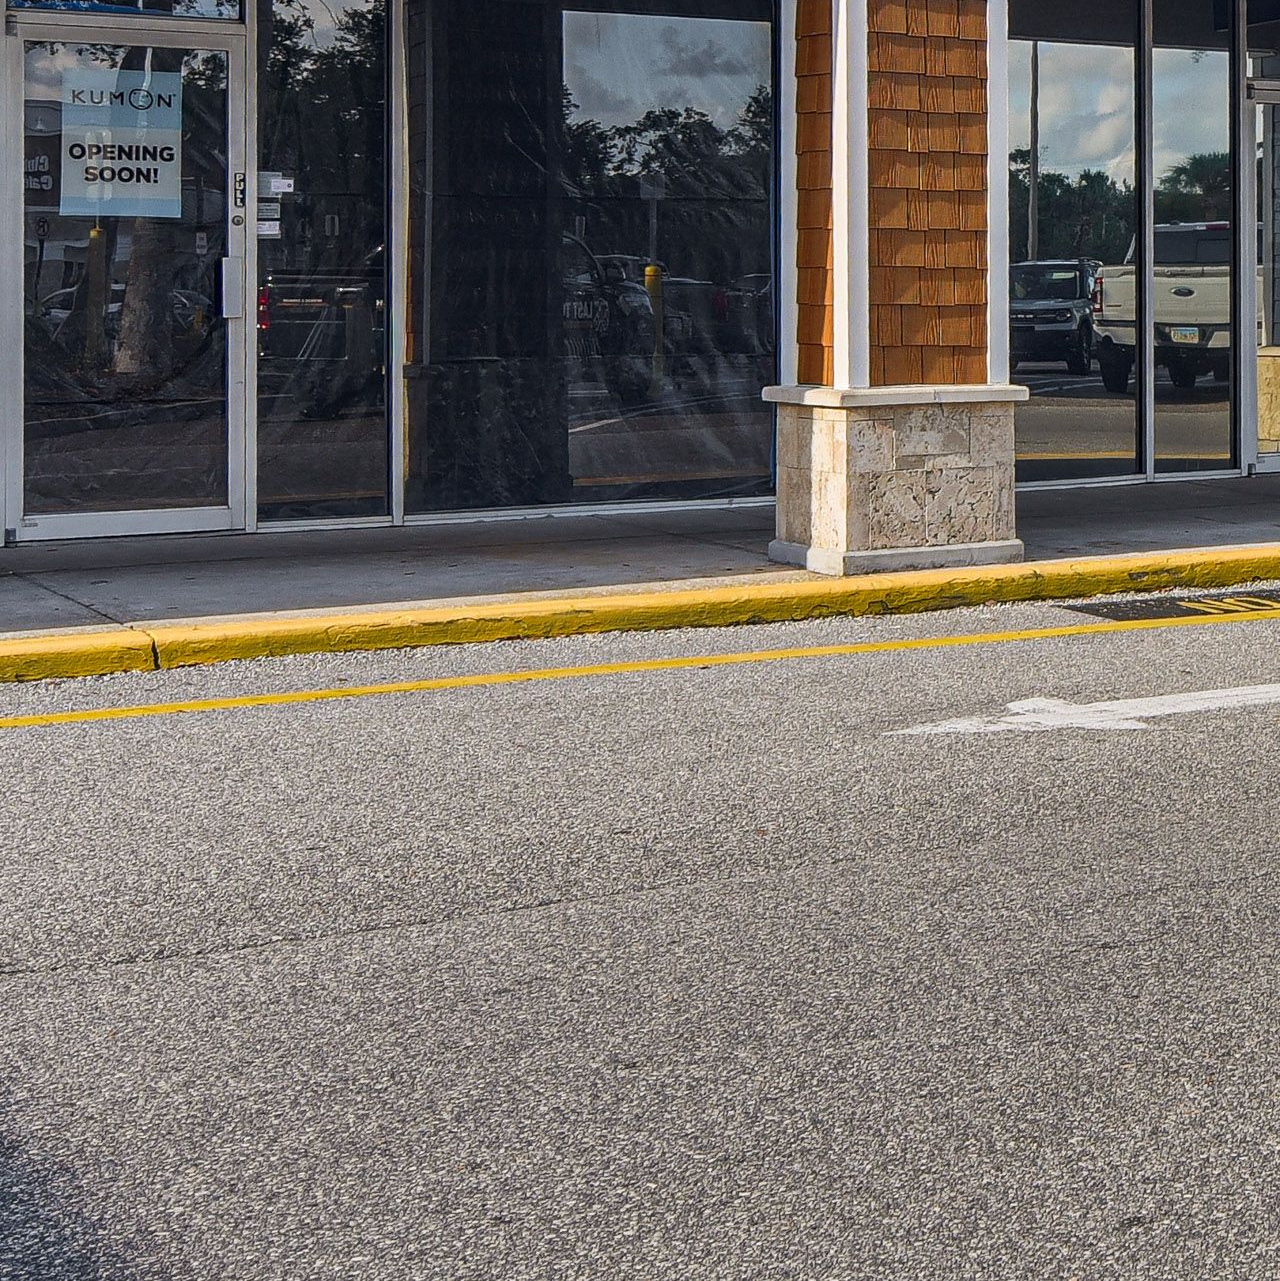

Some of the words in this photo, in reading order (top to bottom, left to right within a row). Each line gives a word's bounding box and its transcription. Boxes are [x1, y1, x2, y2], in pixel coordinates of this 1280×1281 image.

[71, 88, 172, 110] KUMON
[68, 143, 175, 162] OPENING
[84, 165, 159, 184] SOON!
[235, 173, 245, 207] PULL
